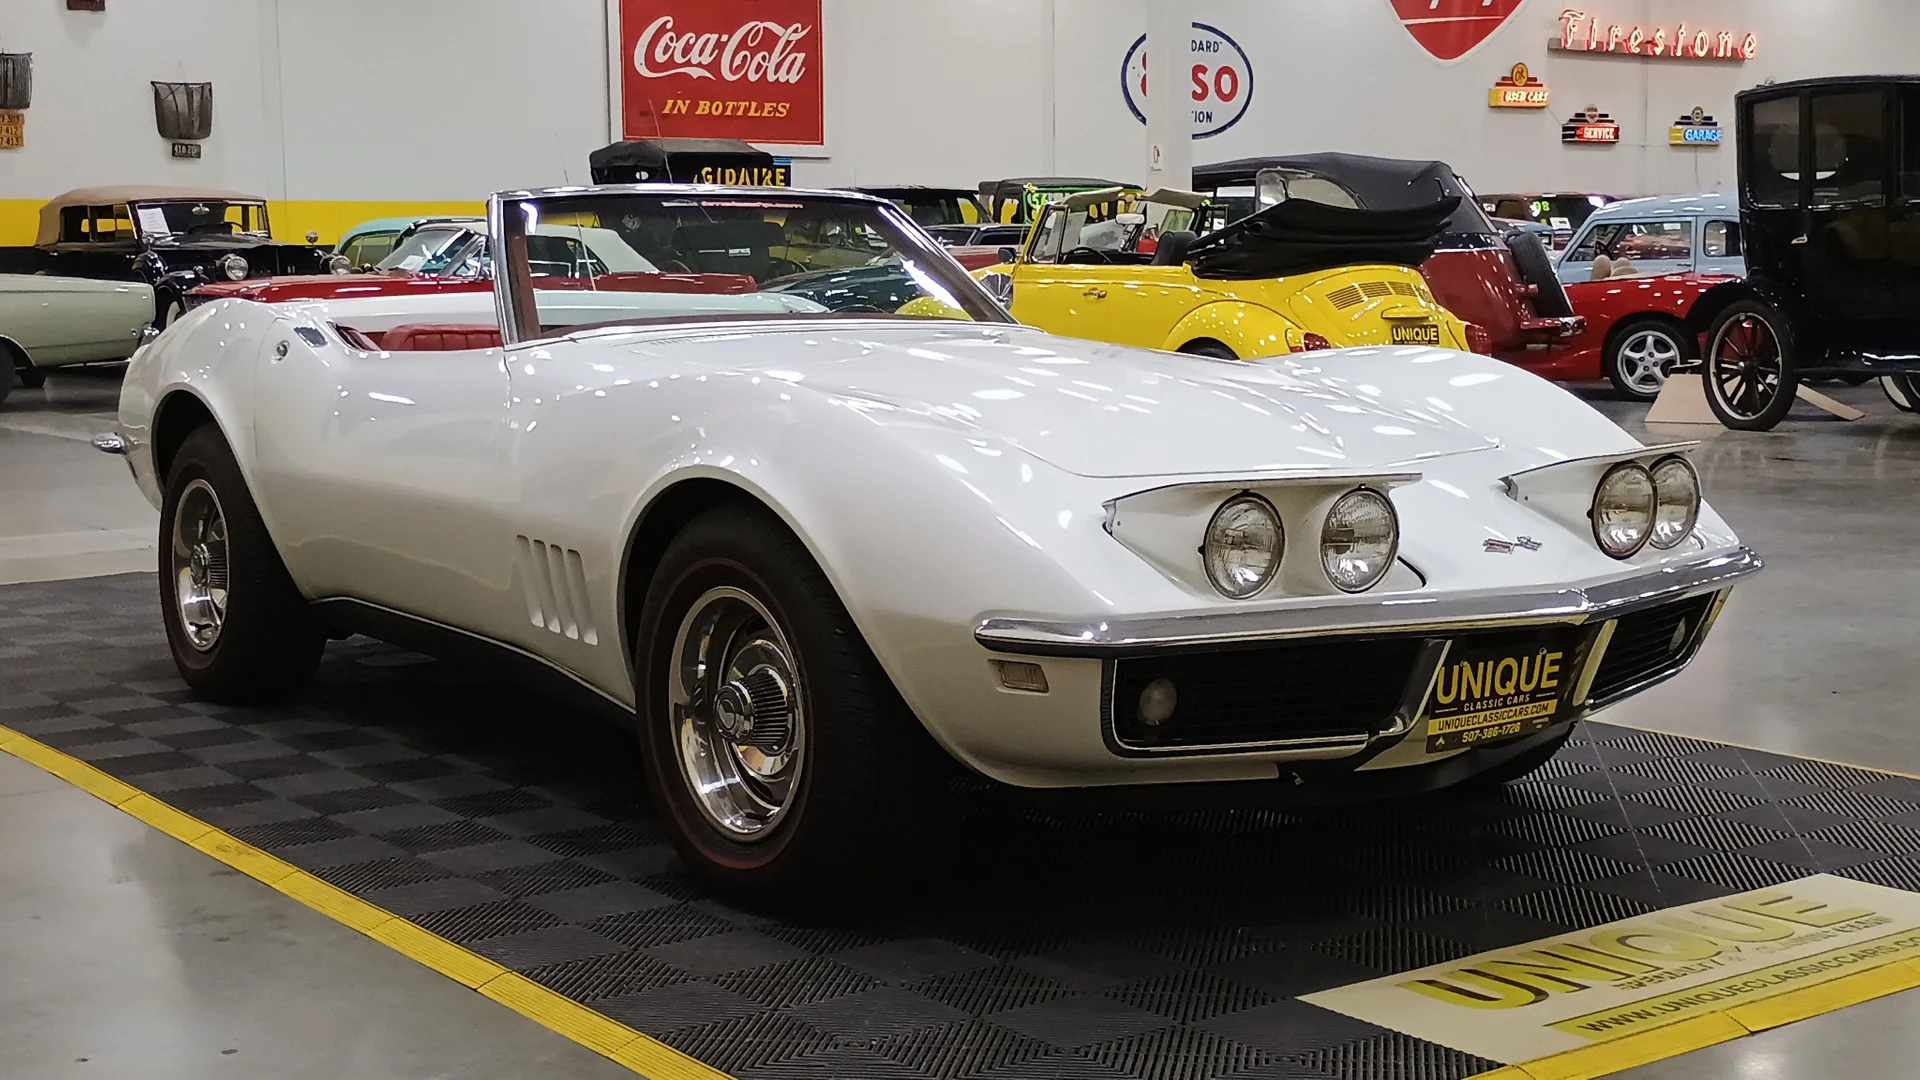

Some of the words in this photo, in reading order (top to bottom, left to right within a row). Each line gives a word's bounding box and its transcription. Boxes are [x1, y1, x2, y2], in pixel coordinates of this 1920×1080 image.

[1559, 9, 1757, 60] Firestone
[634, 16, 812, 84] Coca-Cola
[1191, 40, 1218, 53] DARD
[662, 100, 691, 114] IN
[695, 101, 790, 118] BOTTLES
[1584, 127, 1615, 139] SERVICE
[1684, 128, 1721, 141] GARAGE
[693, 167, 786, 187] GIDAIRE
[1393, 327, 1438, 341] UNIQUE
[1437, 652, 1563, 704] UNIQUE
[1464, 699, 1504, 711] CLASSIC
[1506, 694, 1531, 704] CARS
[1438, 703, 1549, 731] UNIQUECLASSICCARS.COM
[1395, 890, 1877, 1009] UNIQUE
